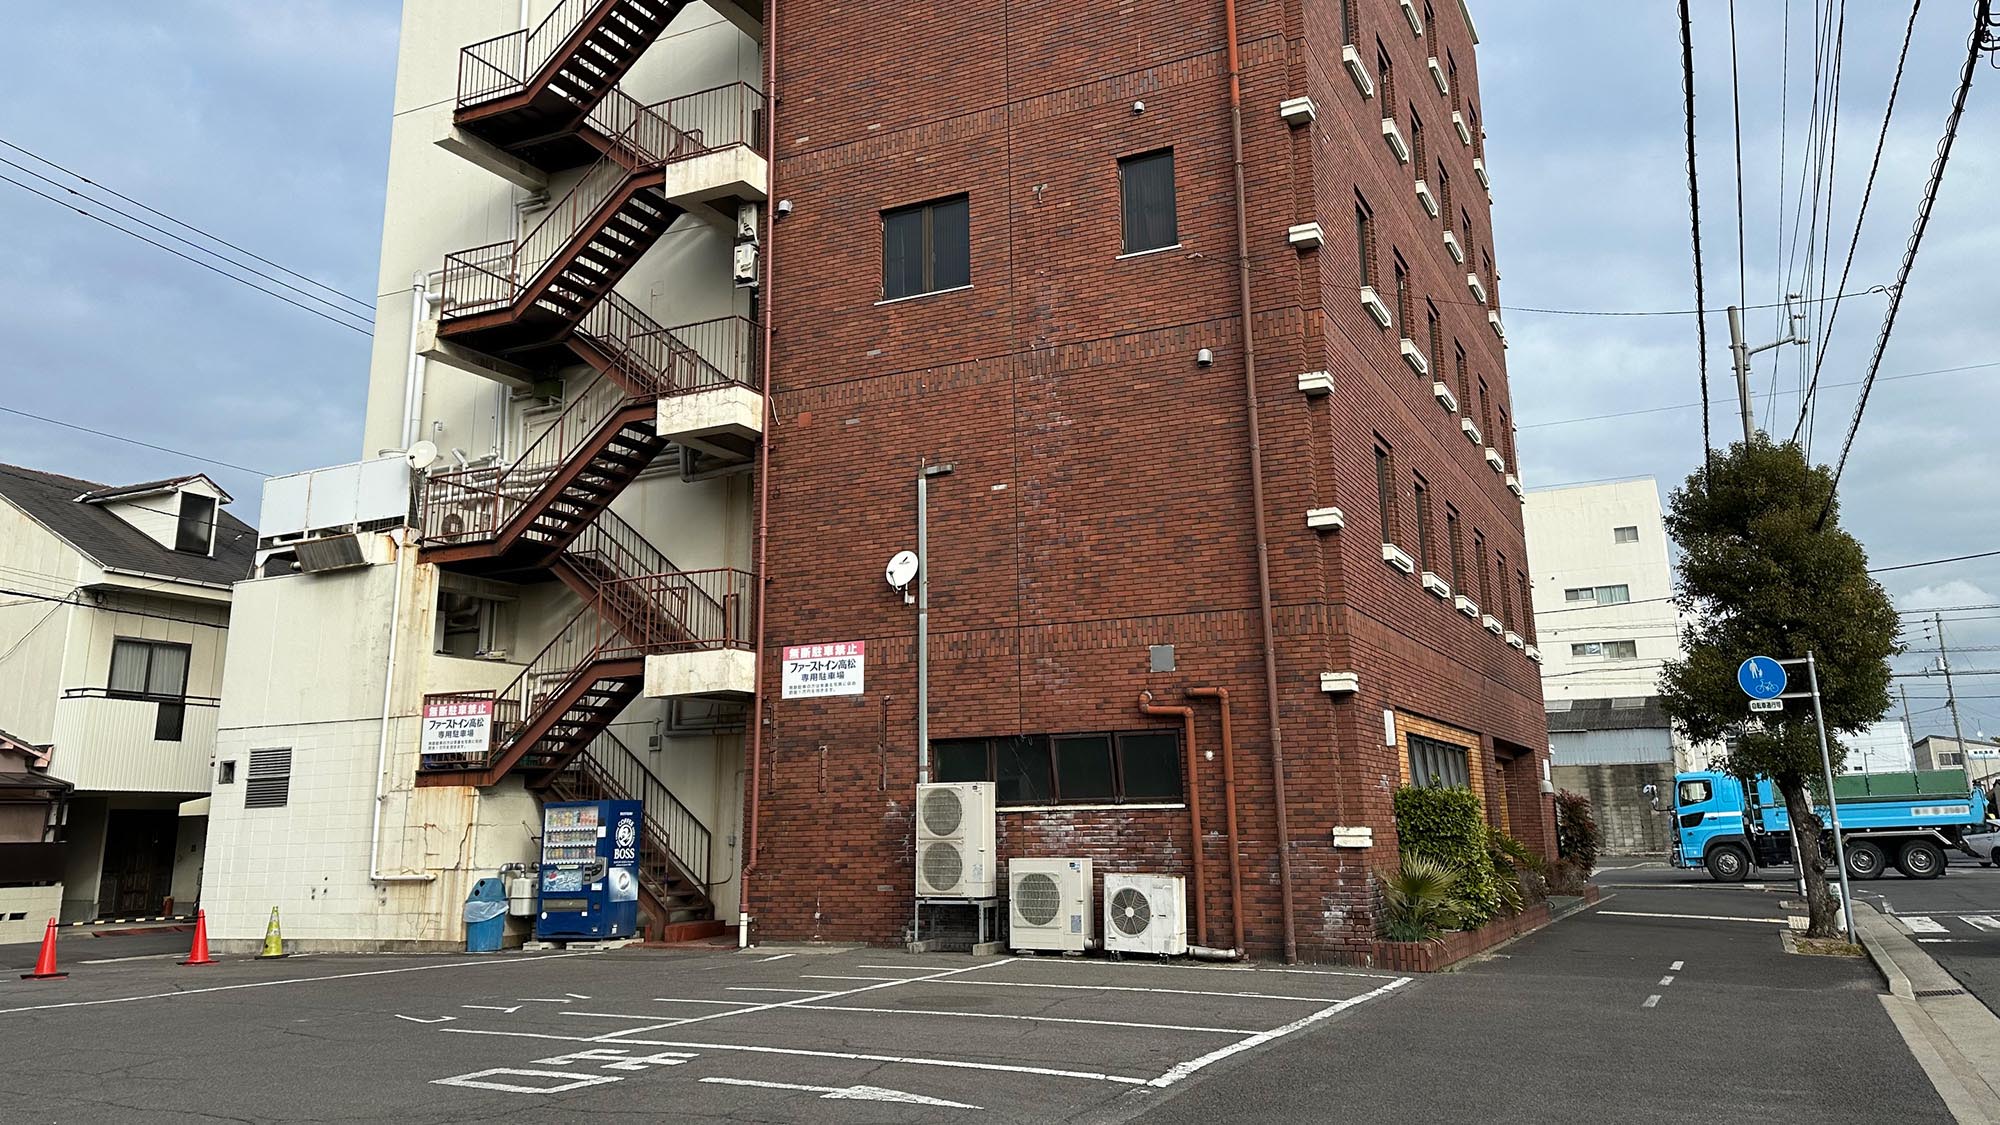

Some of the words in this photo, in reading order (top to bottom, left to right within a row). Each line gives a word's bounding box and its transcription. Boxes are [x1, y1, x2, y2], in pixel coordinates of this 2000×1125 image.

[789, 644, 857, 659] 無断駐車禁止
[790, 658, 856, 673] ファーストイン高松
[801, 671, 844, 682] 専用駐車場
[429, 704, 486, 716] 無断駐車禁止
[429, 717, 484, 730] ファーストイン高松
[438, 729, 474, 738] 専用駐車場
[614, 848, 635, 859] BOSS
